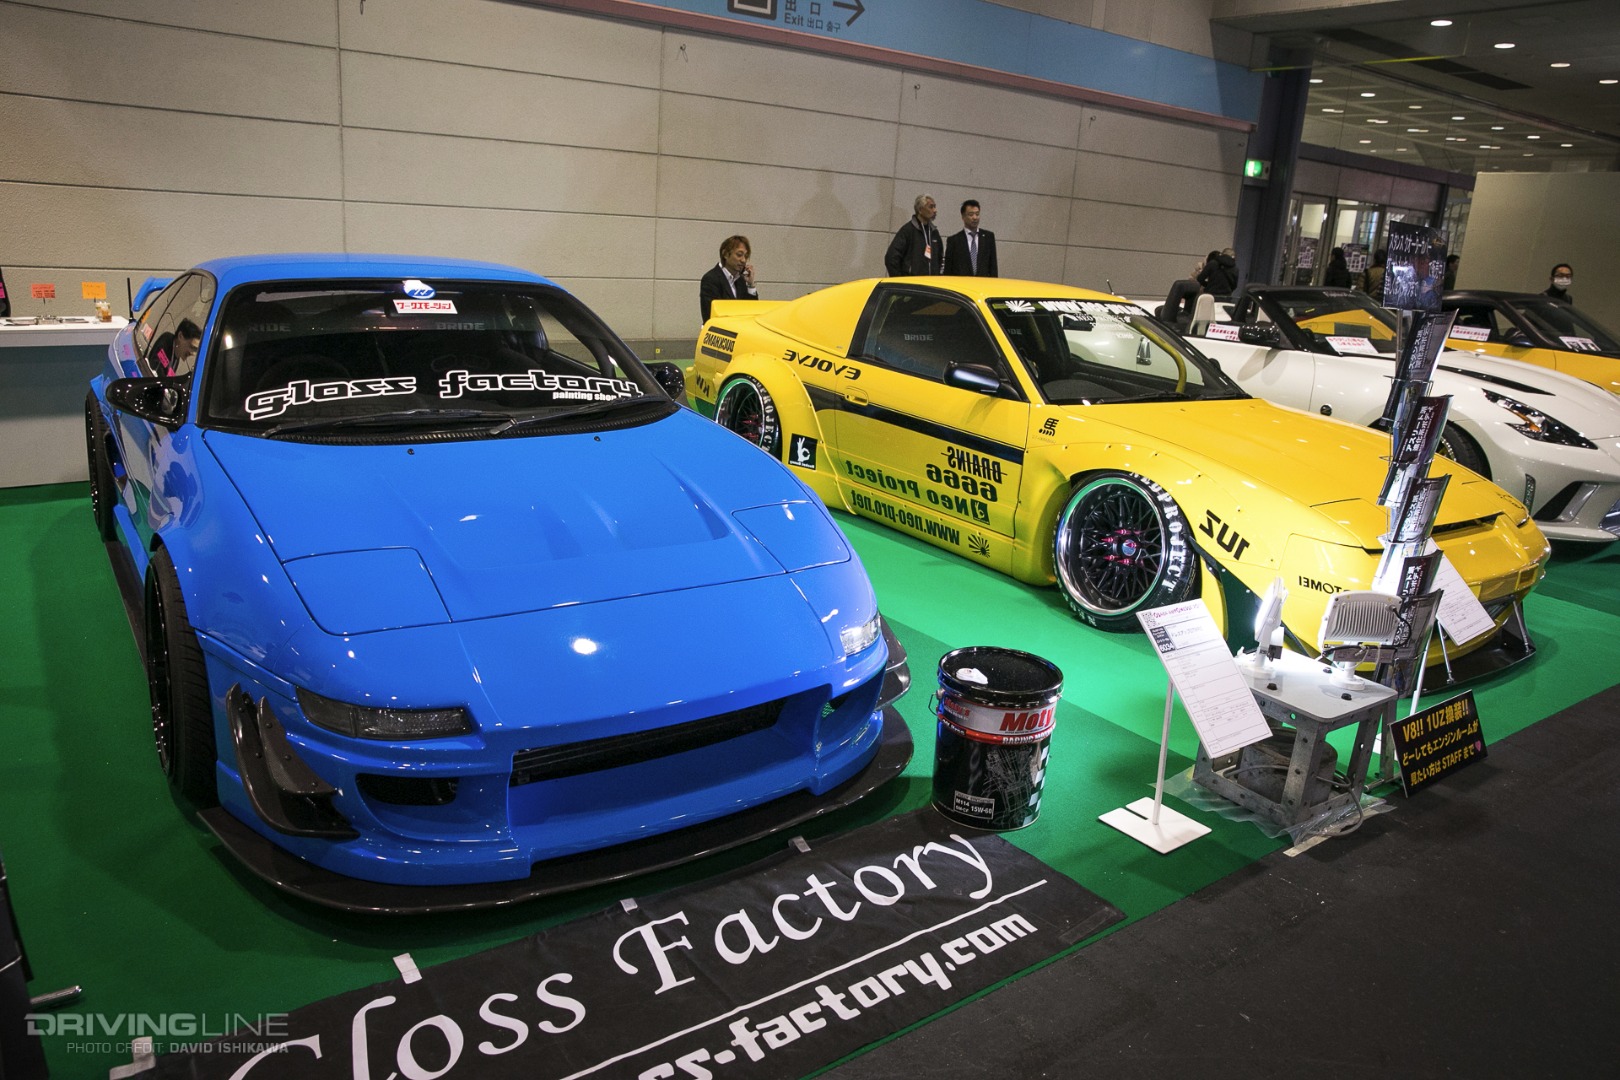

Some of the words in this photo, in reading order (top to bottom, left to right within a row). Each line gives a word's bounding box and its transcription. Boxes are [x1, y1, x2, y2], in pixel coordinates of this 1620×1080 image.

[784, 12, 804, 27] Exit
[807, 17, 823, 30] 出口
[252, 322, 292, 332] RIDE
[437, 322, 486, 331] BRIDE
[903, 333, 934, 341] BRIDE
[246, 377, 416, 421] gloss
[439, 369, 644, 400] factory
[552, 391, 592, 401] painting
[1402, 718, 1424, 742] V8!!
[1402, 719, 1479, 766] どーしてもエンジンルームが
[1442, 749, 1462, 770] STAFF
[612, 833, 993, 996] Factory
